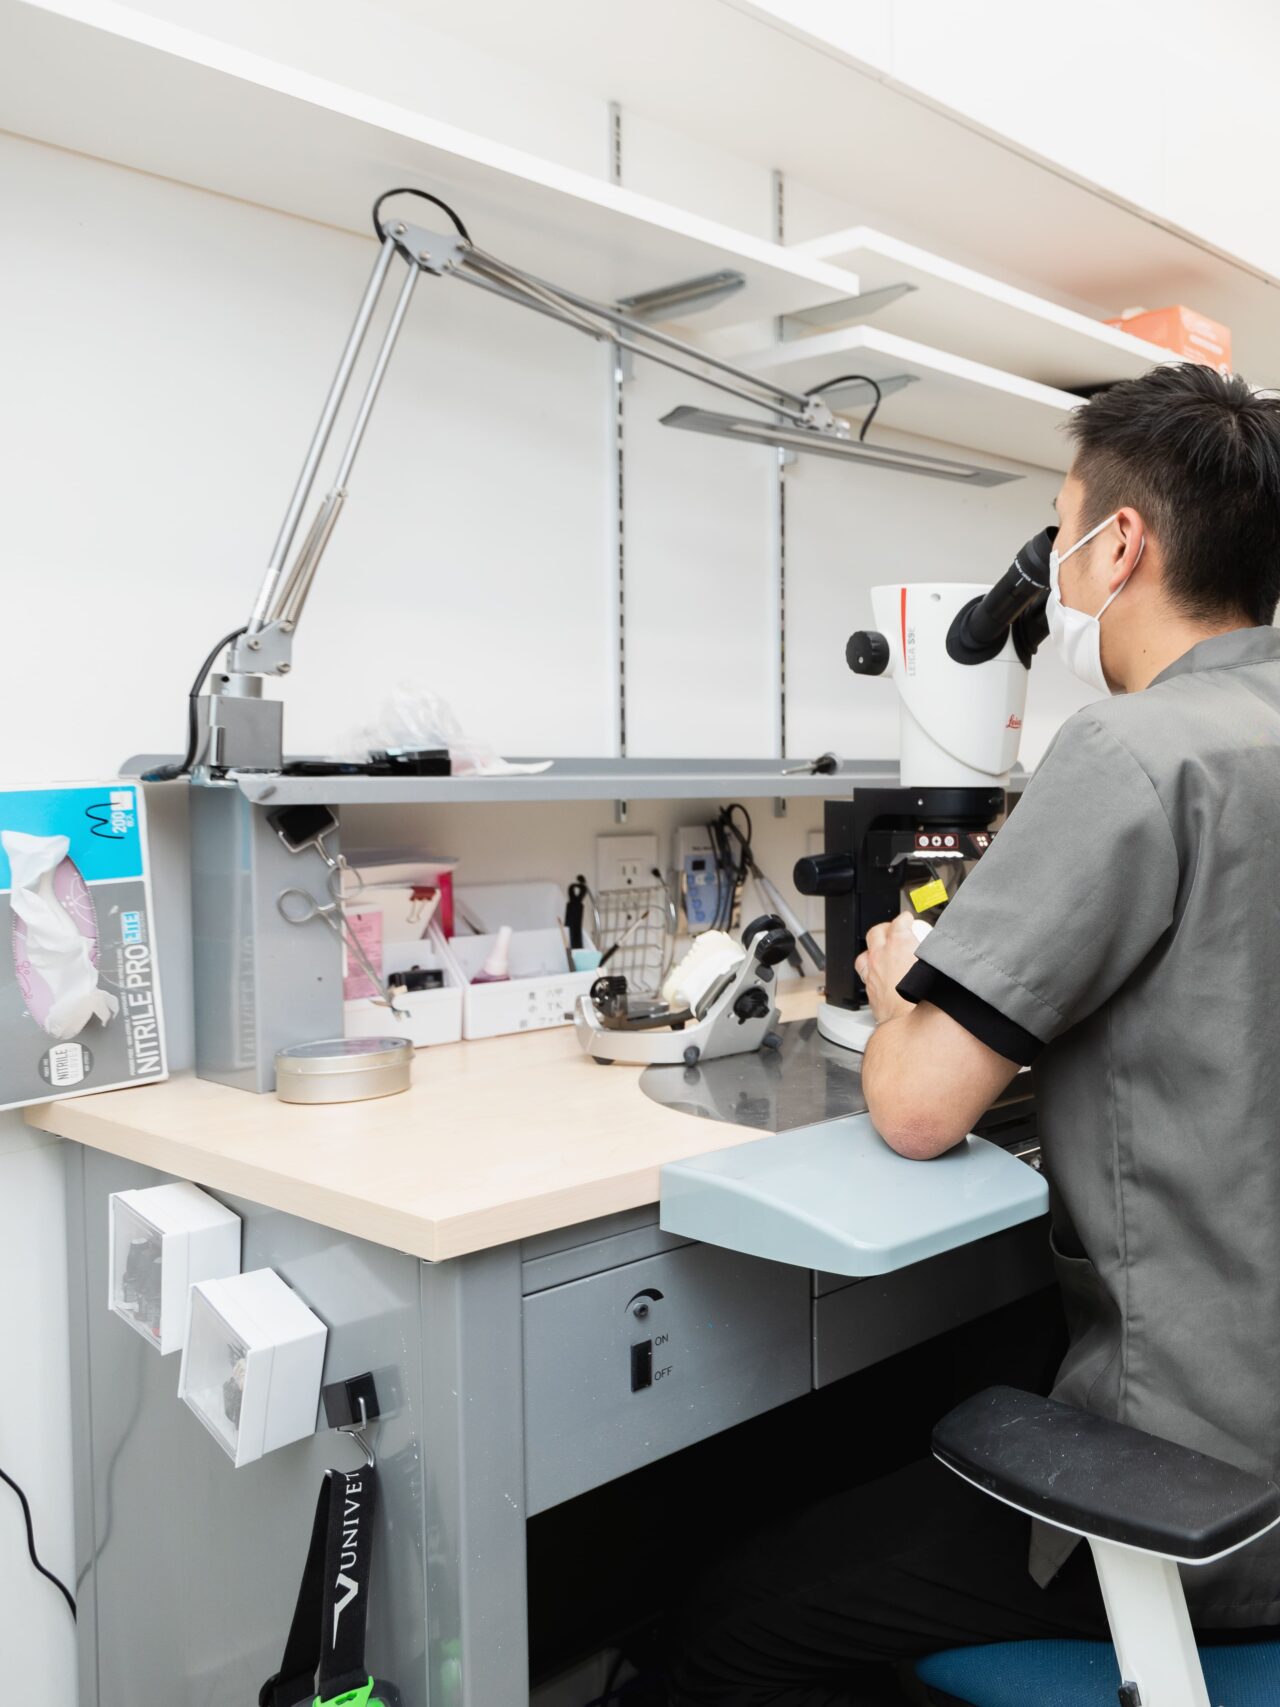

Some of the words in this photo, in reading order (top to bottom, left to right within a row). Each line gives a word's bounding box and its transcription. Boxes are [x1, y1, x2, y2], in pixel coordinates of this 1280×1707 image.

[111, 811, 128, 833] 200
[124, 944, 151, 989] PRO
[129, 991, 161, 1074] NITRILE
[55, 1049, 69, 1080] NITRILE
[654, 1333, 669, 1346] ON
[654, 1365, 673, 1381] OFF
